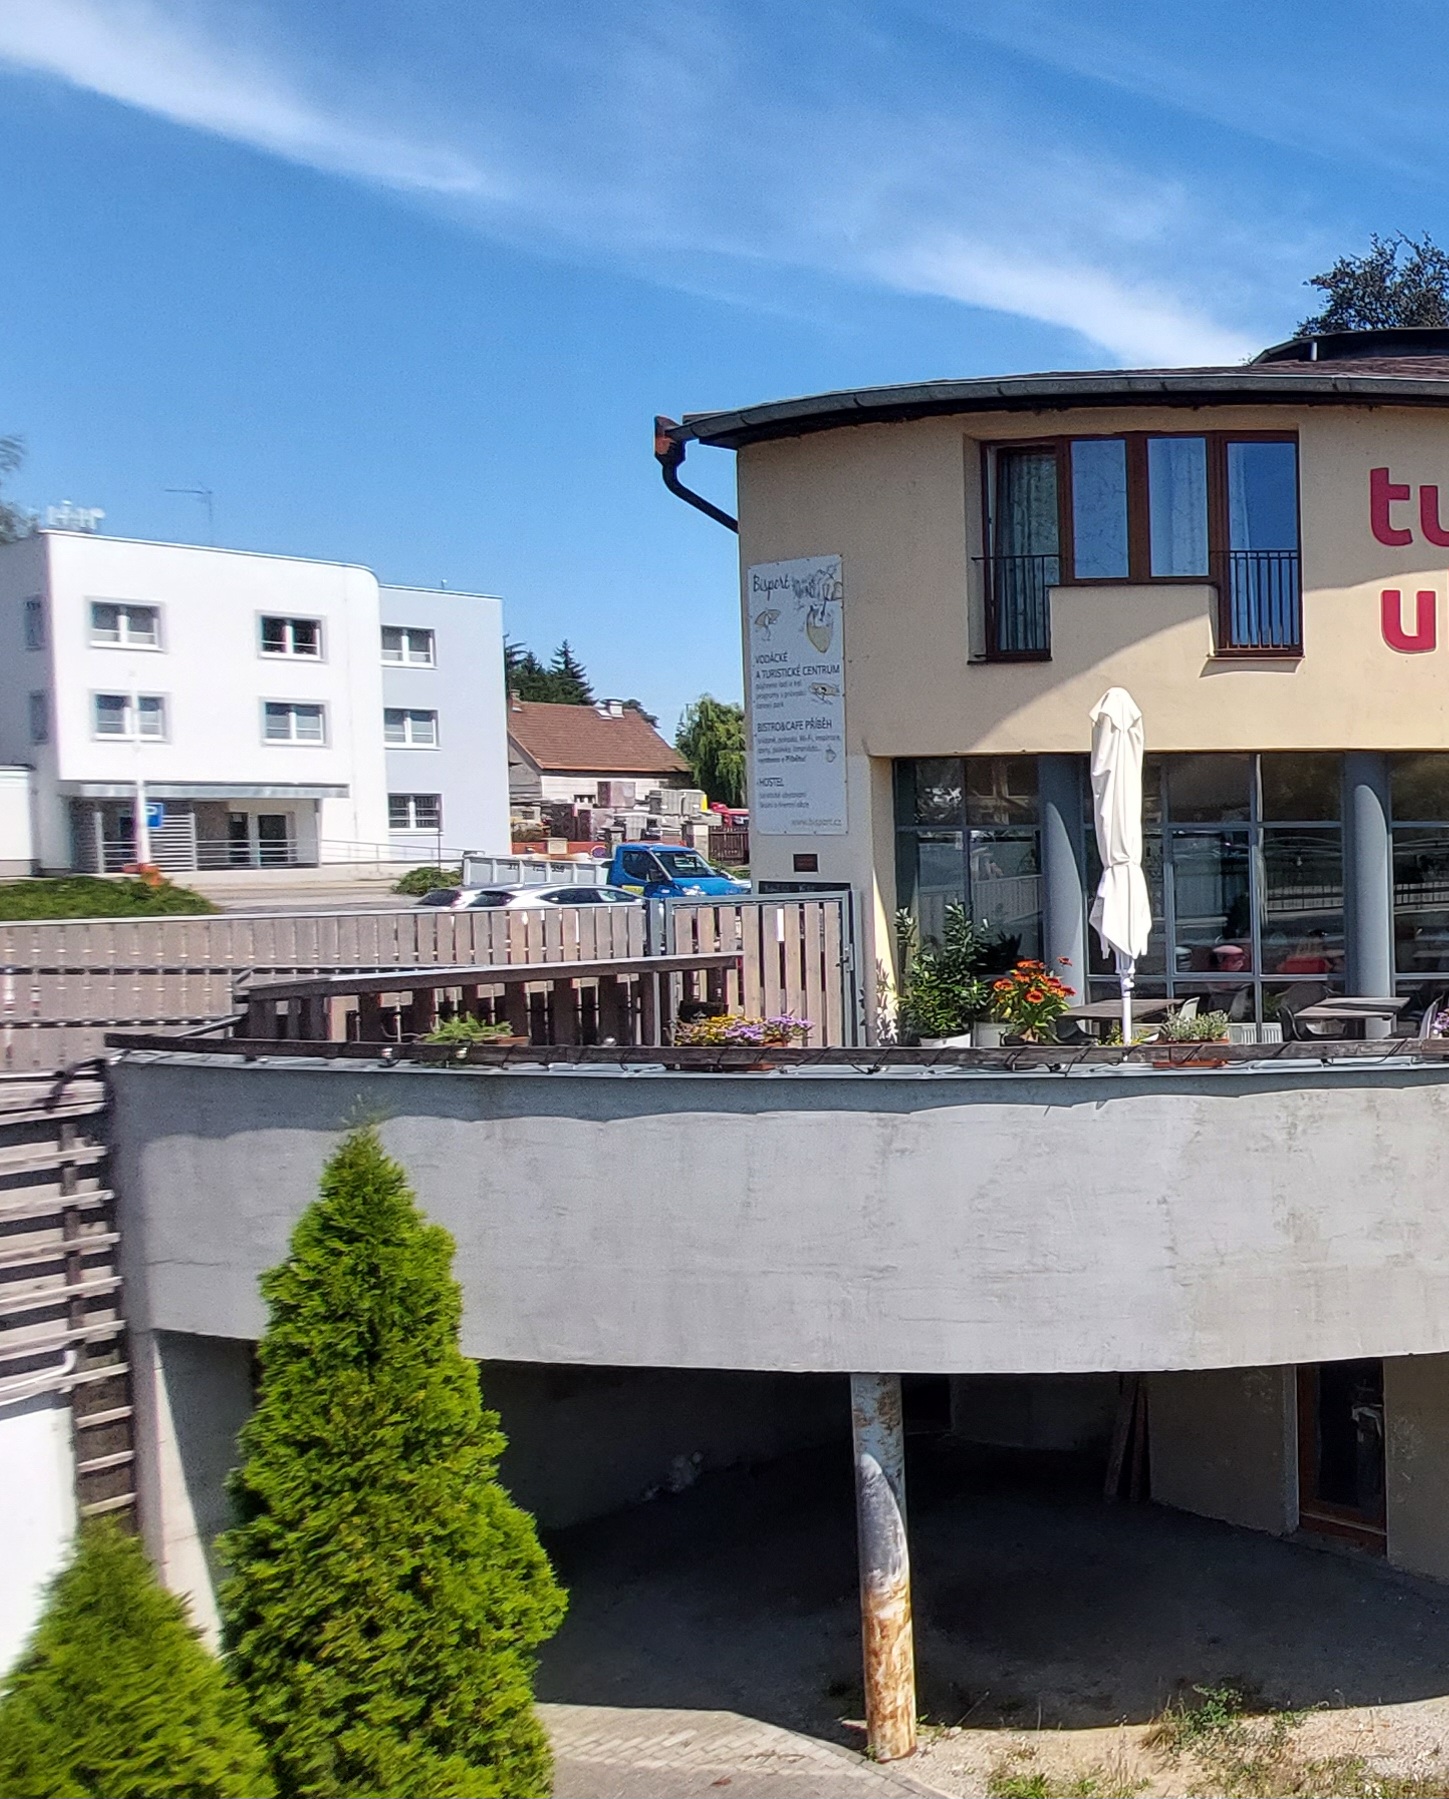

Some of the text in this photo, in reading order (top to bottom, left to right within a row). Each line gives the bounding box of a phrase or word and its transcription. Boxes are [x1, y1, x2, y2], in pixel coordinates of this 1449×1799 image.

[755, 651, 788, 664] VODÁCKÉ
[761, 664, 801, 679] TURISTICKÉ
[802, 664, 840, 676] CENTRUM
[805, 717, 832, 730] PŘÍBĚH
